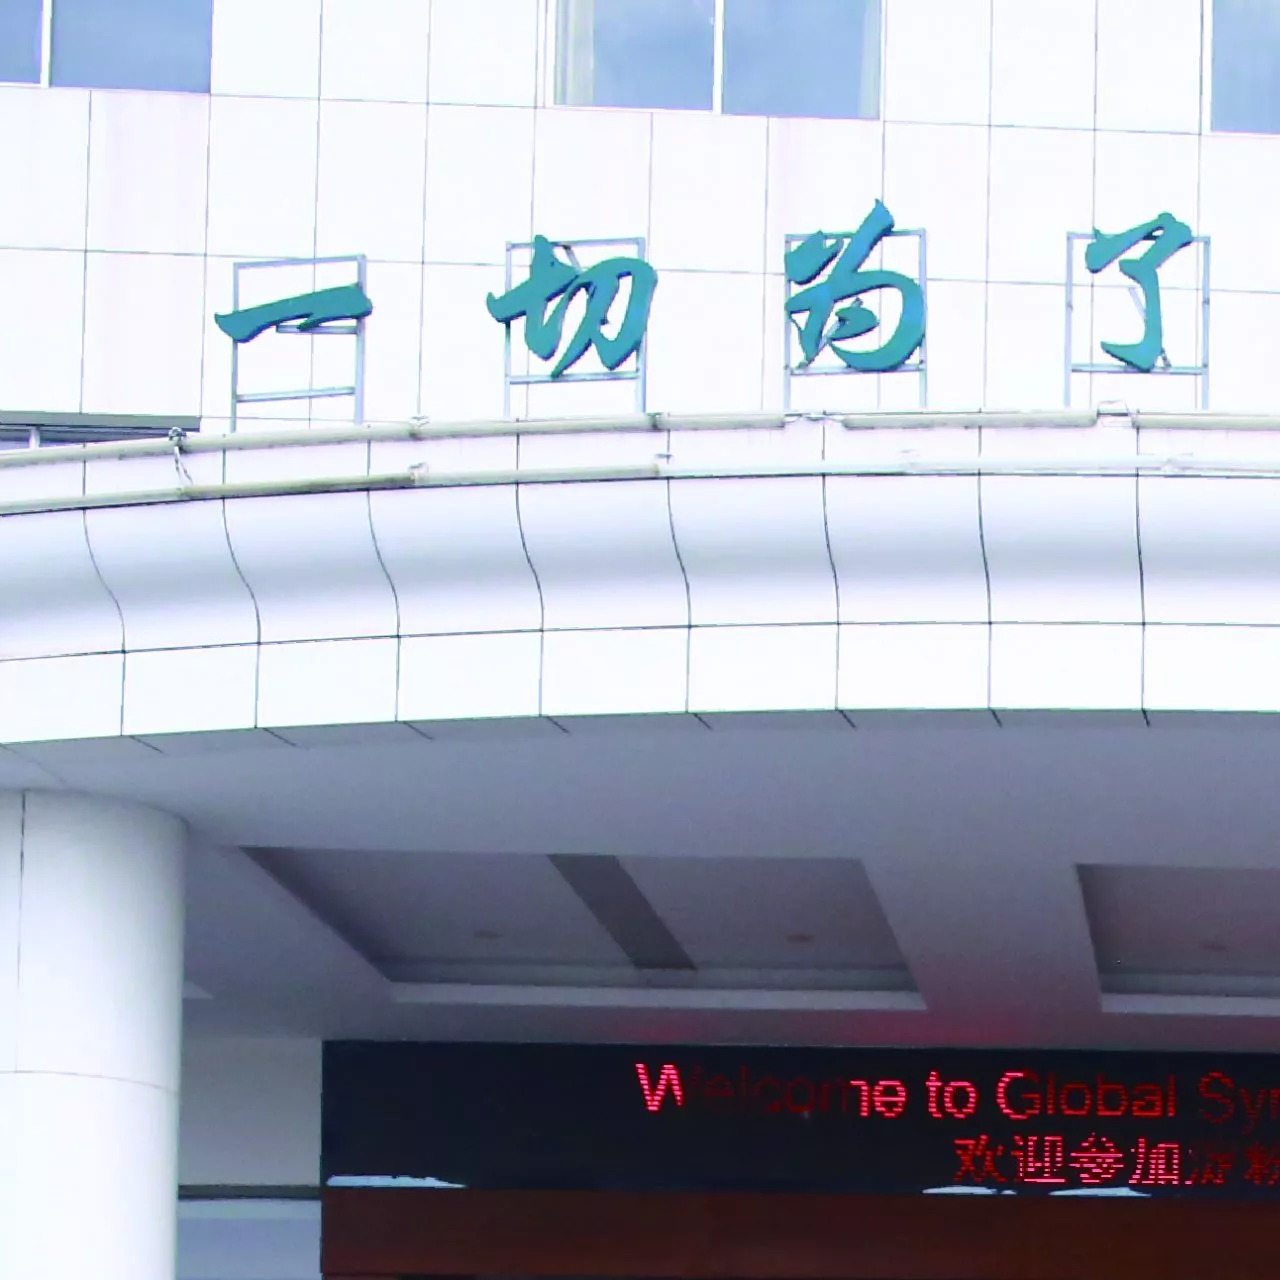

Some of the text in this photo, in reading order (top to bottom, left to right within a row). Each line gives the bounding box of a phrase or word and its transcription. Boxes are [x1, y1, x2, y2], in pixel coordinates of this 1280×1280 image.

[635, 1062, 907, 1118] Welcome
[925, 1070, 978, 1120] to
[995, 1071, 1176, 1121] Global
